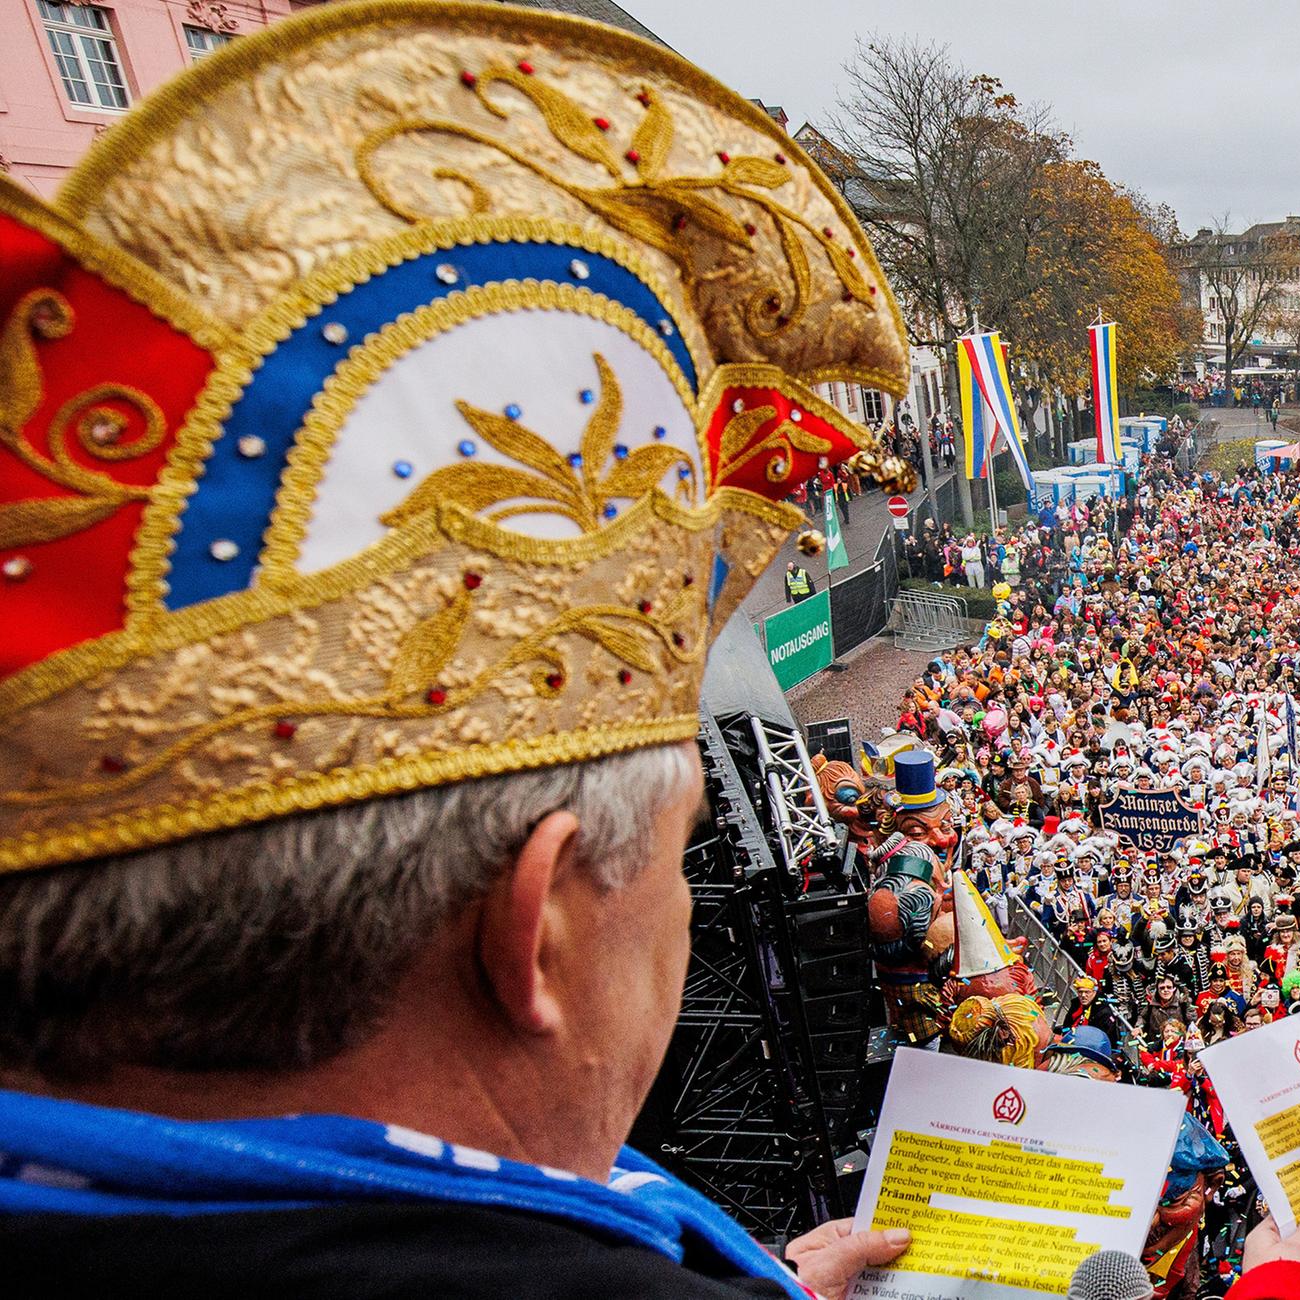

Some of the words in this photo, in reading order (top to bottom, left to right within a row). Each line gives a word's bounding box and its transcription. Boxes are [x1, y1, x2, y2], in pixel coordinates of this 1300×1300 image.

[770, 620, 829, 666] NOTAUSGANG
[1120, 794, 1179, 816] Mainzer
[1104, 812, 1198, 833] Ranzengarde
[1137, 832, 1174, 850] 1837
[929, 1121, 976, 1134] NÄRRISCHES
[889, 1146, 951, 1165] Grundgesetz,
[953, 1157, 974, 1168] dass
[975, 1160, 1031, 1177] ausdrücklich
[1033, 1169, 1047, 1179] für
[1048, 1172, 1065, 1182] alle
[1067, 1173, 1124, 1190] Geschlechter
[967, 1146, 986, 1156] Wir
[987, 1149, 1023, 1162] verlesen
[1024, 1155, 1044, 1166] jetzt
[1046, 1158, 1062, 1168] das
[1063, 1160, 1103, 1174] närrische
[879, 1187, 931, 1204] Präambel
[882, 1173, 925, 1190] sprechen
[927, 1181, 943, 1190] wir
[945, 1184, 958, 1193] im
[960, 1186, 1024, 1205] Nachfolgenden
[1027, 1198, 1042, 1206] nur
[1064, 1203, 1079, 1211] von
[1081, 1204, 1097, 1213] den
[1100, 1205, 1131, 1218] Narren
[885, 1159, 905, 1171] gilt,
[907, 1163, 928, 1174] aber
[930, 1169, 960, 1181] wegen
[963, 1171, 977, 1182] der
[979, 1174, 1049, 1194] Verständlichkeit
[1051, 1185, 1068, 1195] und
[1069, 1188, 1109, 1202] Tradition
[871, 1213, 939, 1234] nachfolgenden
[1034, 1238, 1049, 1248] alle
[876, 1200, 910, 1214] Unsere
[911, 1206, 947, 1222] goldige
[1027, 1224, 1044, 1234] soll
[1044, 1226, 1060, 1236] für
[1060, 1228, 1076, 1238] alle
